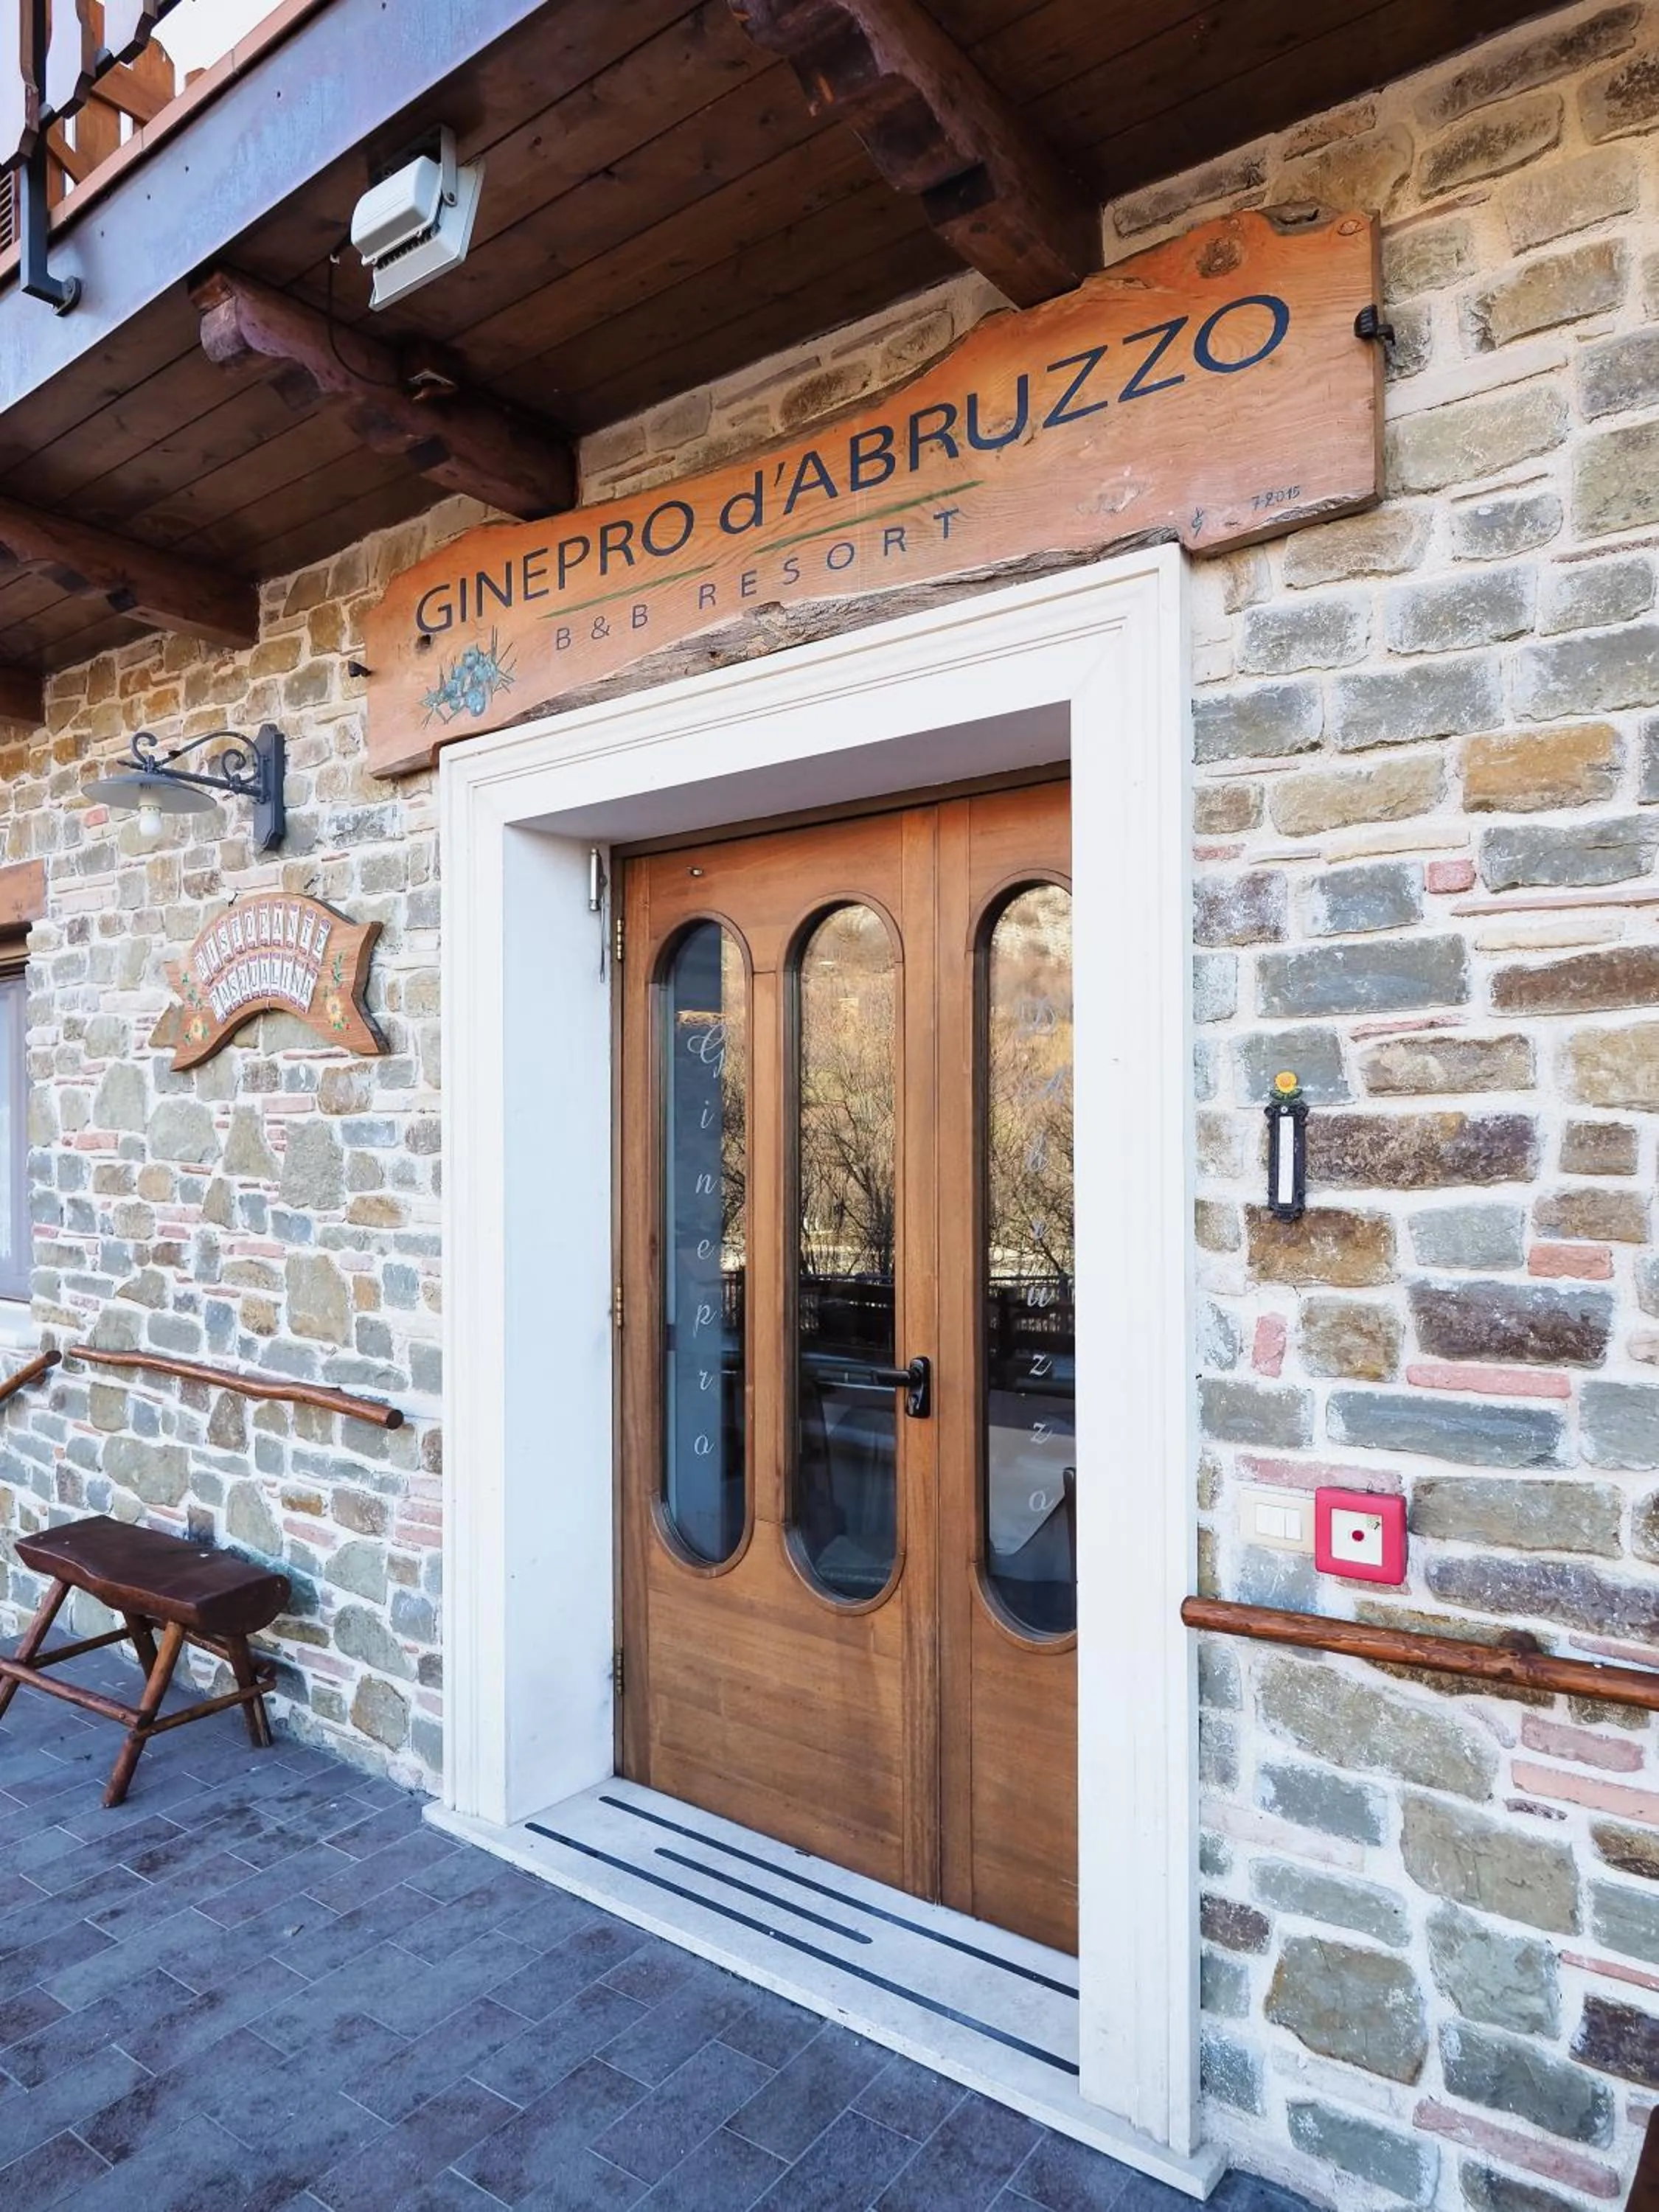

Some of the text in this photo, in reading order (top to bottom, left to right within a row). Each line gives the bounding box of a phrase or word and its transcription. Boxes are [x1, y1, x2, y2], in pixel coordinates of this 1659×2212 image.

[416, 295, 1290, 633] GINEPRO d'ABRUZZO
[698, 509, 959, 609] RESORT
[195, 908, 328, 981] RISTORANTE
[211, 959, 314, 1015] PASQUALINA
[686, 1023, 728, 1455] Ginepro
